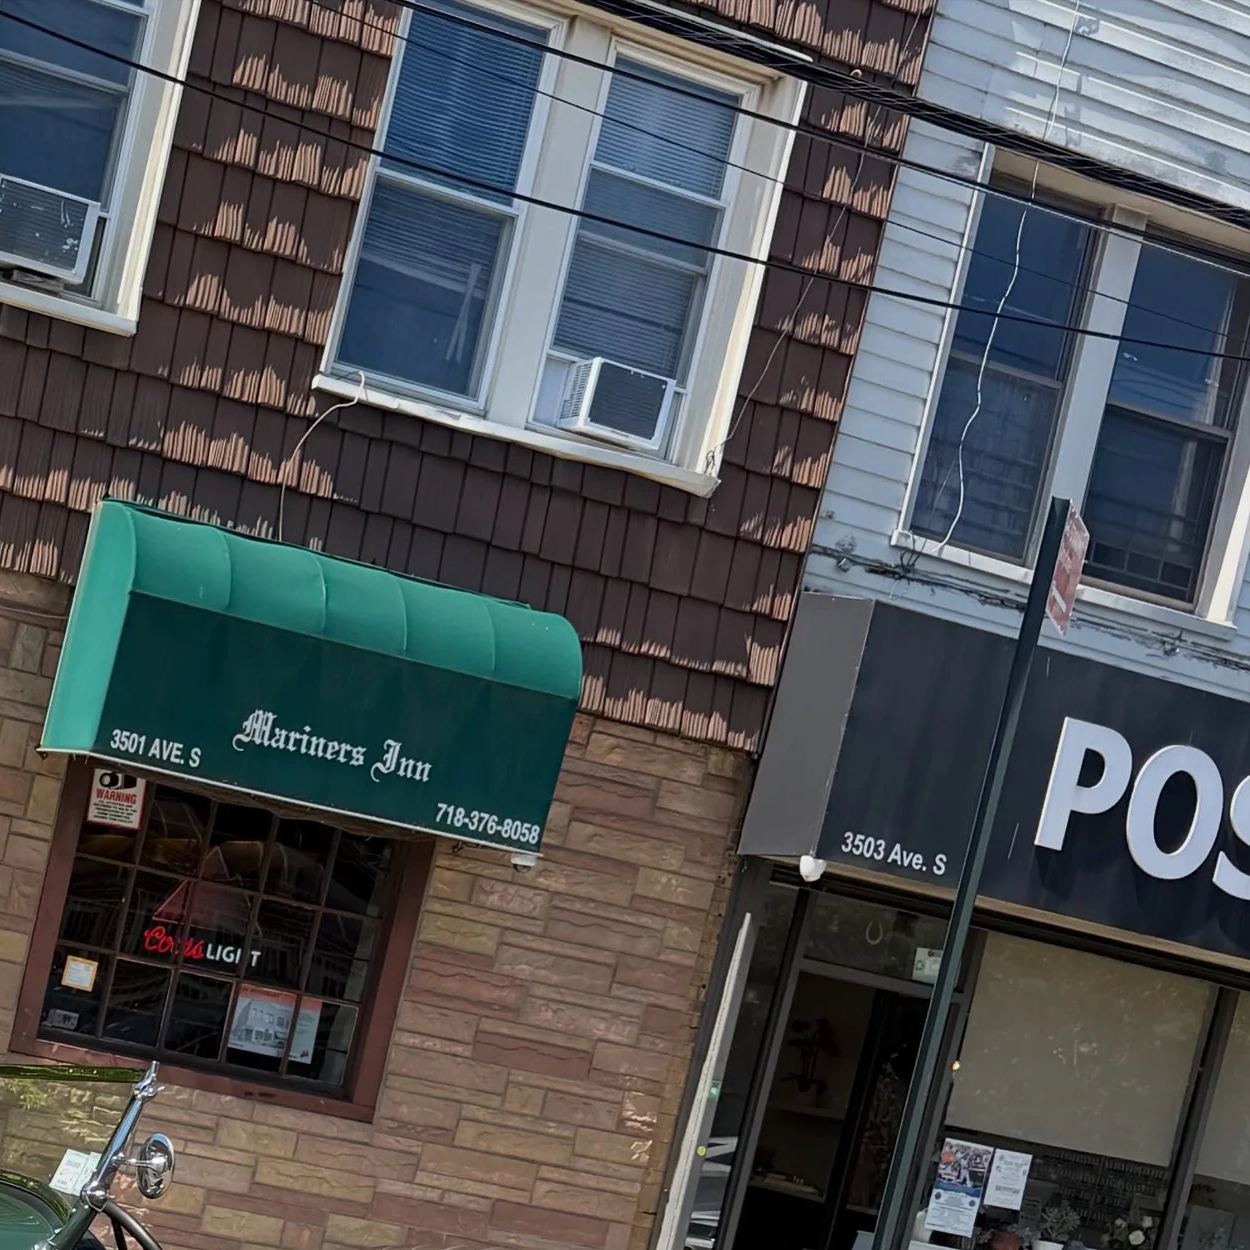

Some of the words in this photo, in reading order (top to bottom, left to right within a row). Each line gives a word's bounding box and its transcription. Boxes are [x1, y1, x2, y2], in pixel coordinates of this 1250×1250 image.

[110, 728, 147, 756] 3501
[147, 737, 185, 765] AVE.
[188, 747, 202, 769] S
[232, 708, 368, 767] Mariners
[370, 738, 433, 783] Inn
[95, 787, 138, 805] WARNING
[435, 802, 541, 845] 718-376-8058
[841, 831, 886, 861] 3503
[887, 842, 928, 874] Ave.
[932, 853, 948, 876] S
[143, 925, 205, 960] Cors
